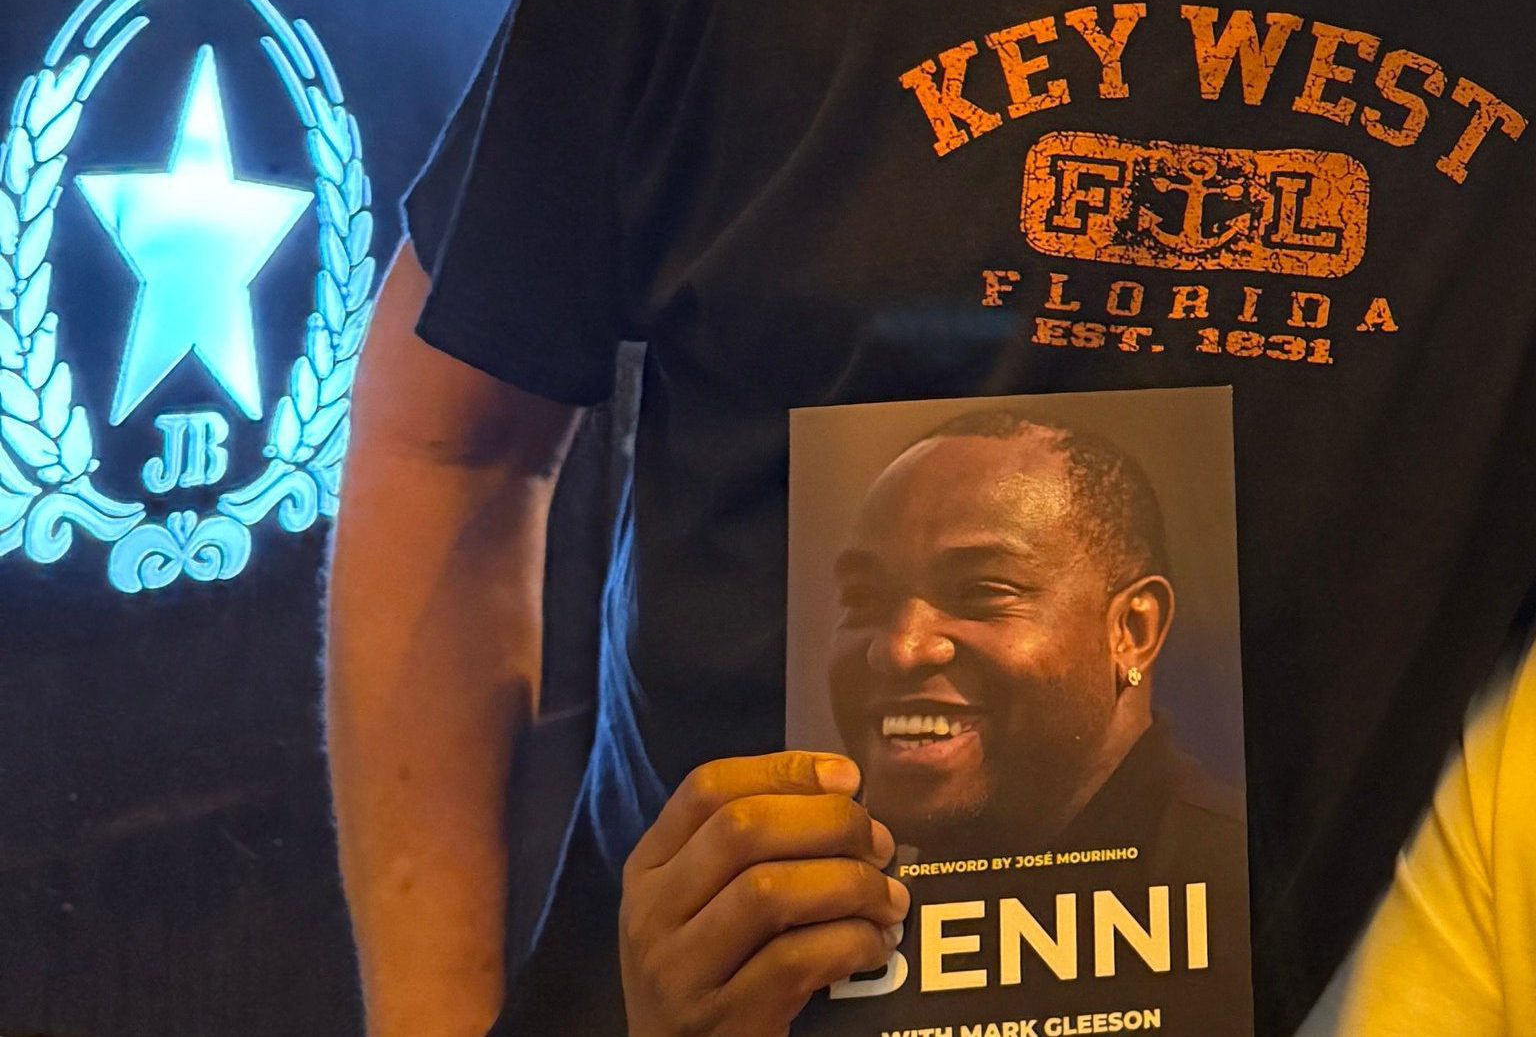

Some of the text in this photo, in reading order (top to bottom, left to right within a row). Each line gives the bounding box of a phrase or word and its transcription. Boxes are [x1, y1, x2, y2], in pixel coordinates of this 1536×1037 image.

[899, 3, 1530, 185] KEY WEST
[981, 270, 1399, 333] FLORIDA
[1032, 317, 1334, 364] EST. 1831
[142, 411, 230, 494] JB
[900, 847, 1139, 878] FOREWORD BY JOSÉ MOURINHO
[1043, 1008, 1162, 1037] GLEESON
